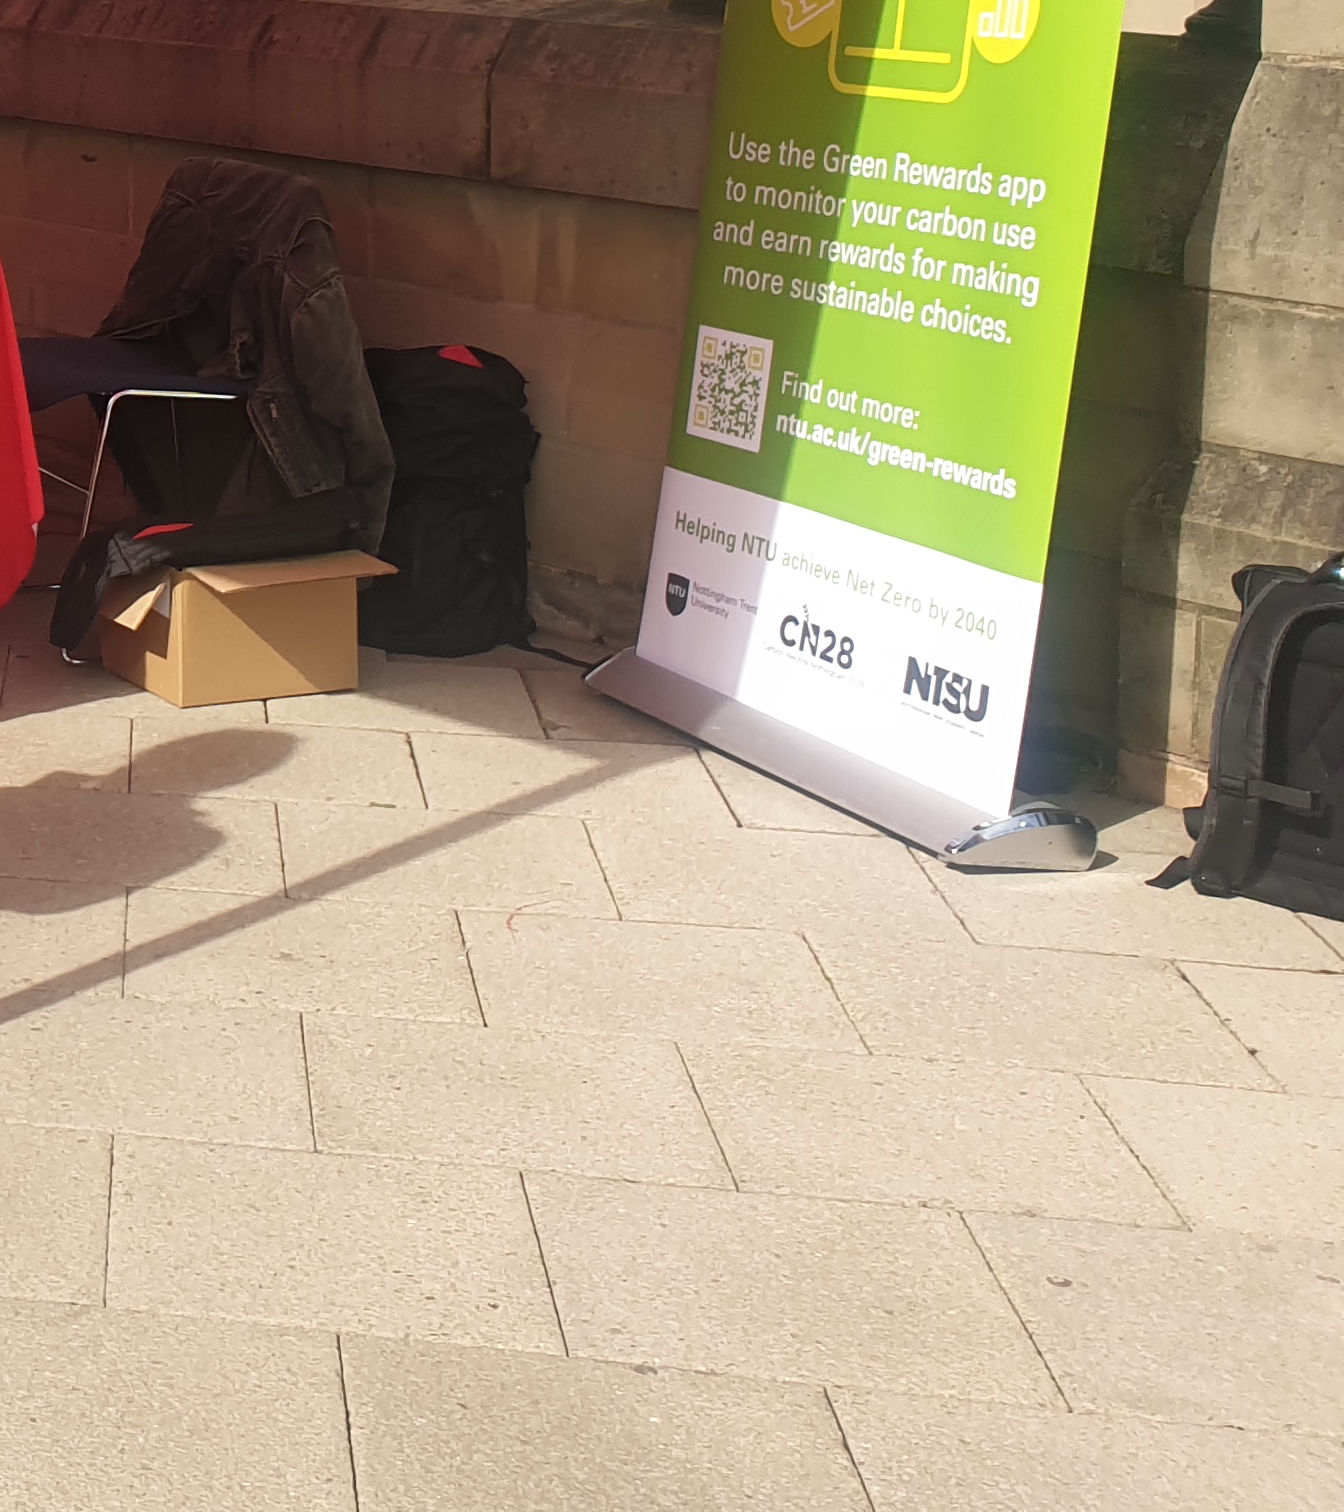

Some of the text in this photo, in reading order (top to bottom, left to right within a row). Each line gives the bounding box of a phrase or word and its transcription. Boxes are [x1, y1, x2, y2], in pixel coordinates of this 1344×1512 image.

[728, 131, 1046, 208] Use the Green Rewards app
[725, 176, 1036, 250] to monitor your carbon use
[713, 219, 1040, 308] and earn rewards for making
[723, 265, 1012, 344] more sustainable choices.
[781, 370, 920, 430] Find out more:
[776, 413, 1017, 499] ntu.ac.uk/green-rewards
[668, 583, 687, 598] NTU
[675, 510, 998, 641] Helping NTU achieve Net Zero by 2040
[690, 595, 730, 620] University
[692, 581, 758, 615] Nottingham Trent
[780, 615, 855, 670] CN28
[903, 655, 990, 723] NTSU
